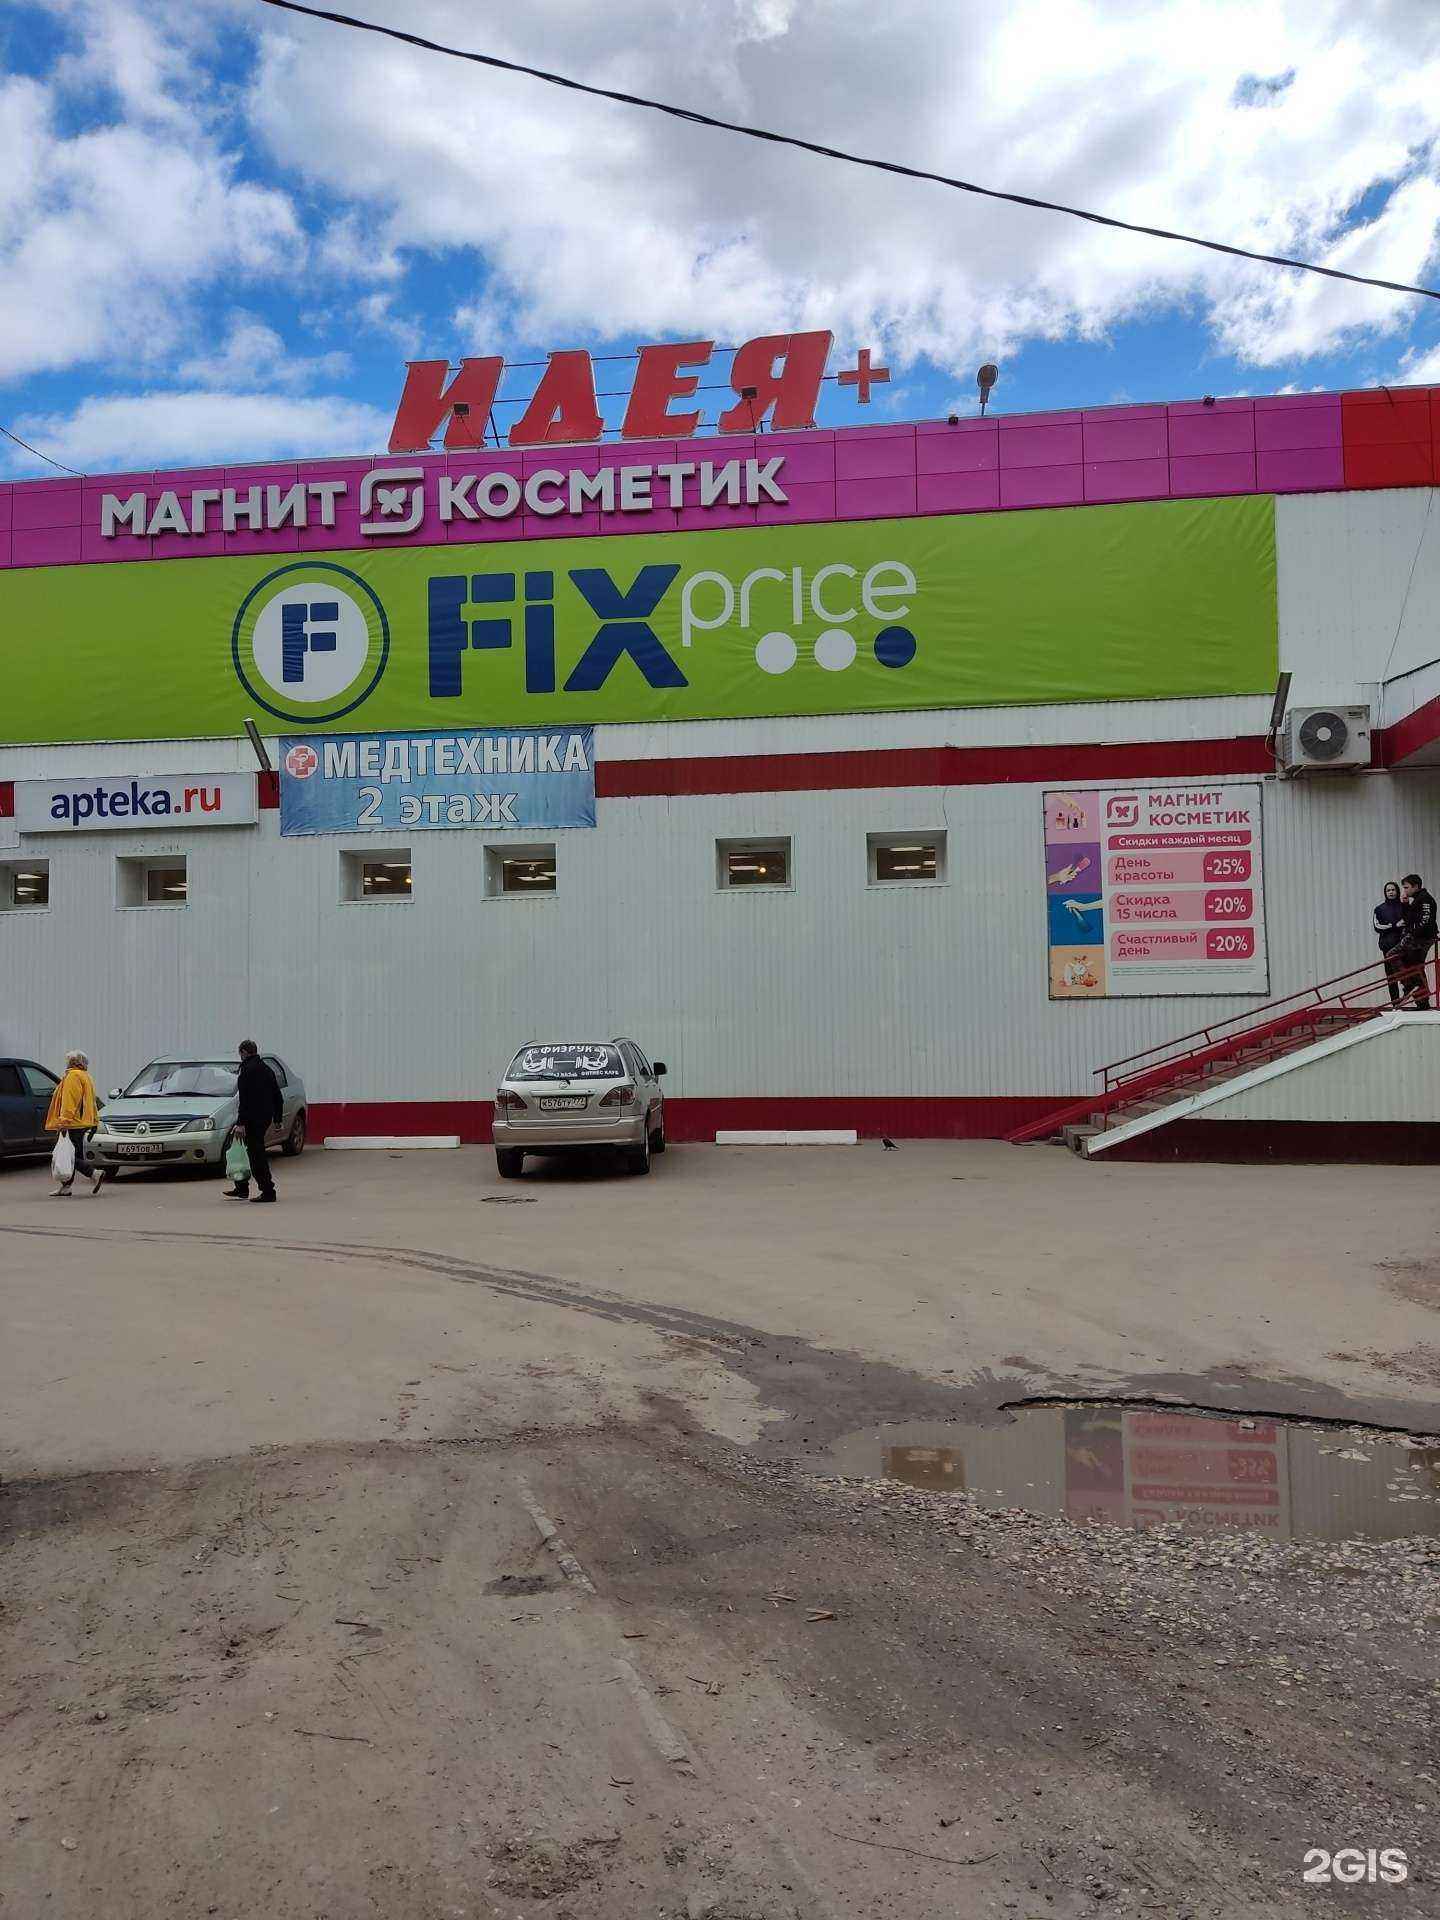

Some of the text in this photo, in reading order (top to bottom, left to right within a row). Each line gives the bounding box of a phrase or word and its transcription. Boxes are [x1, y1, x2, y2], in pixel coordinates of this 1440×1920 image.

[101, 457, 789, 537] МАГНИТ КОСМЕТИК
[681, 560, 918, 647] price
[323, 734, 590, 784] МЕДТЕХНИКА
[50, 782, 221, 826] apteka.ru
[357, 786, 520, 825] 2 этаж
[1148, 792, 1223, 808] МАГНИТ
[1149, 810, 1250, 827] КОСМЕТИК
[1118, 834, 1242, 848] Скидки каждый месяц
[1114, 857, 1151, 870] День
[1206, 858, 1245, 875] -25%
[1114, 871, 1174, 883] красоты
[1116, 895, 1170, 907] Скидка
[1208, 897, 1247, 913] -20%
[1116, 908, 1177, 919] 15 числа
[1117, 931, 1198, 945] Счастливый
[1209, 935, 1248, 952] -20%
[1117, 945, 1151, 957] день
[540, 1045, 593, 1055] ФИЗРУК
